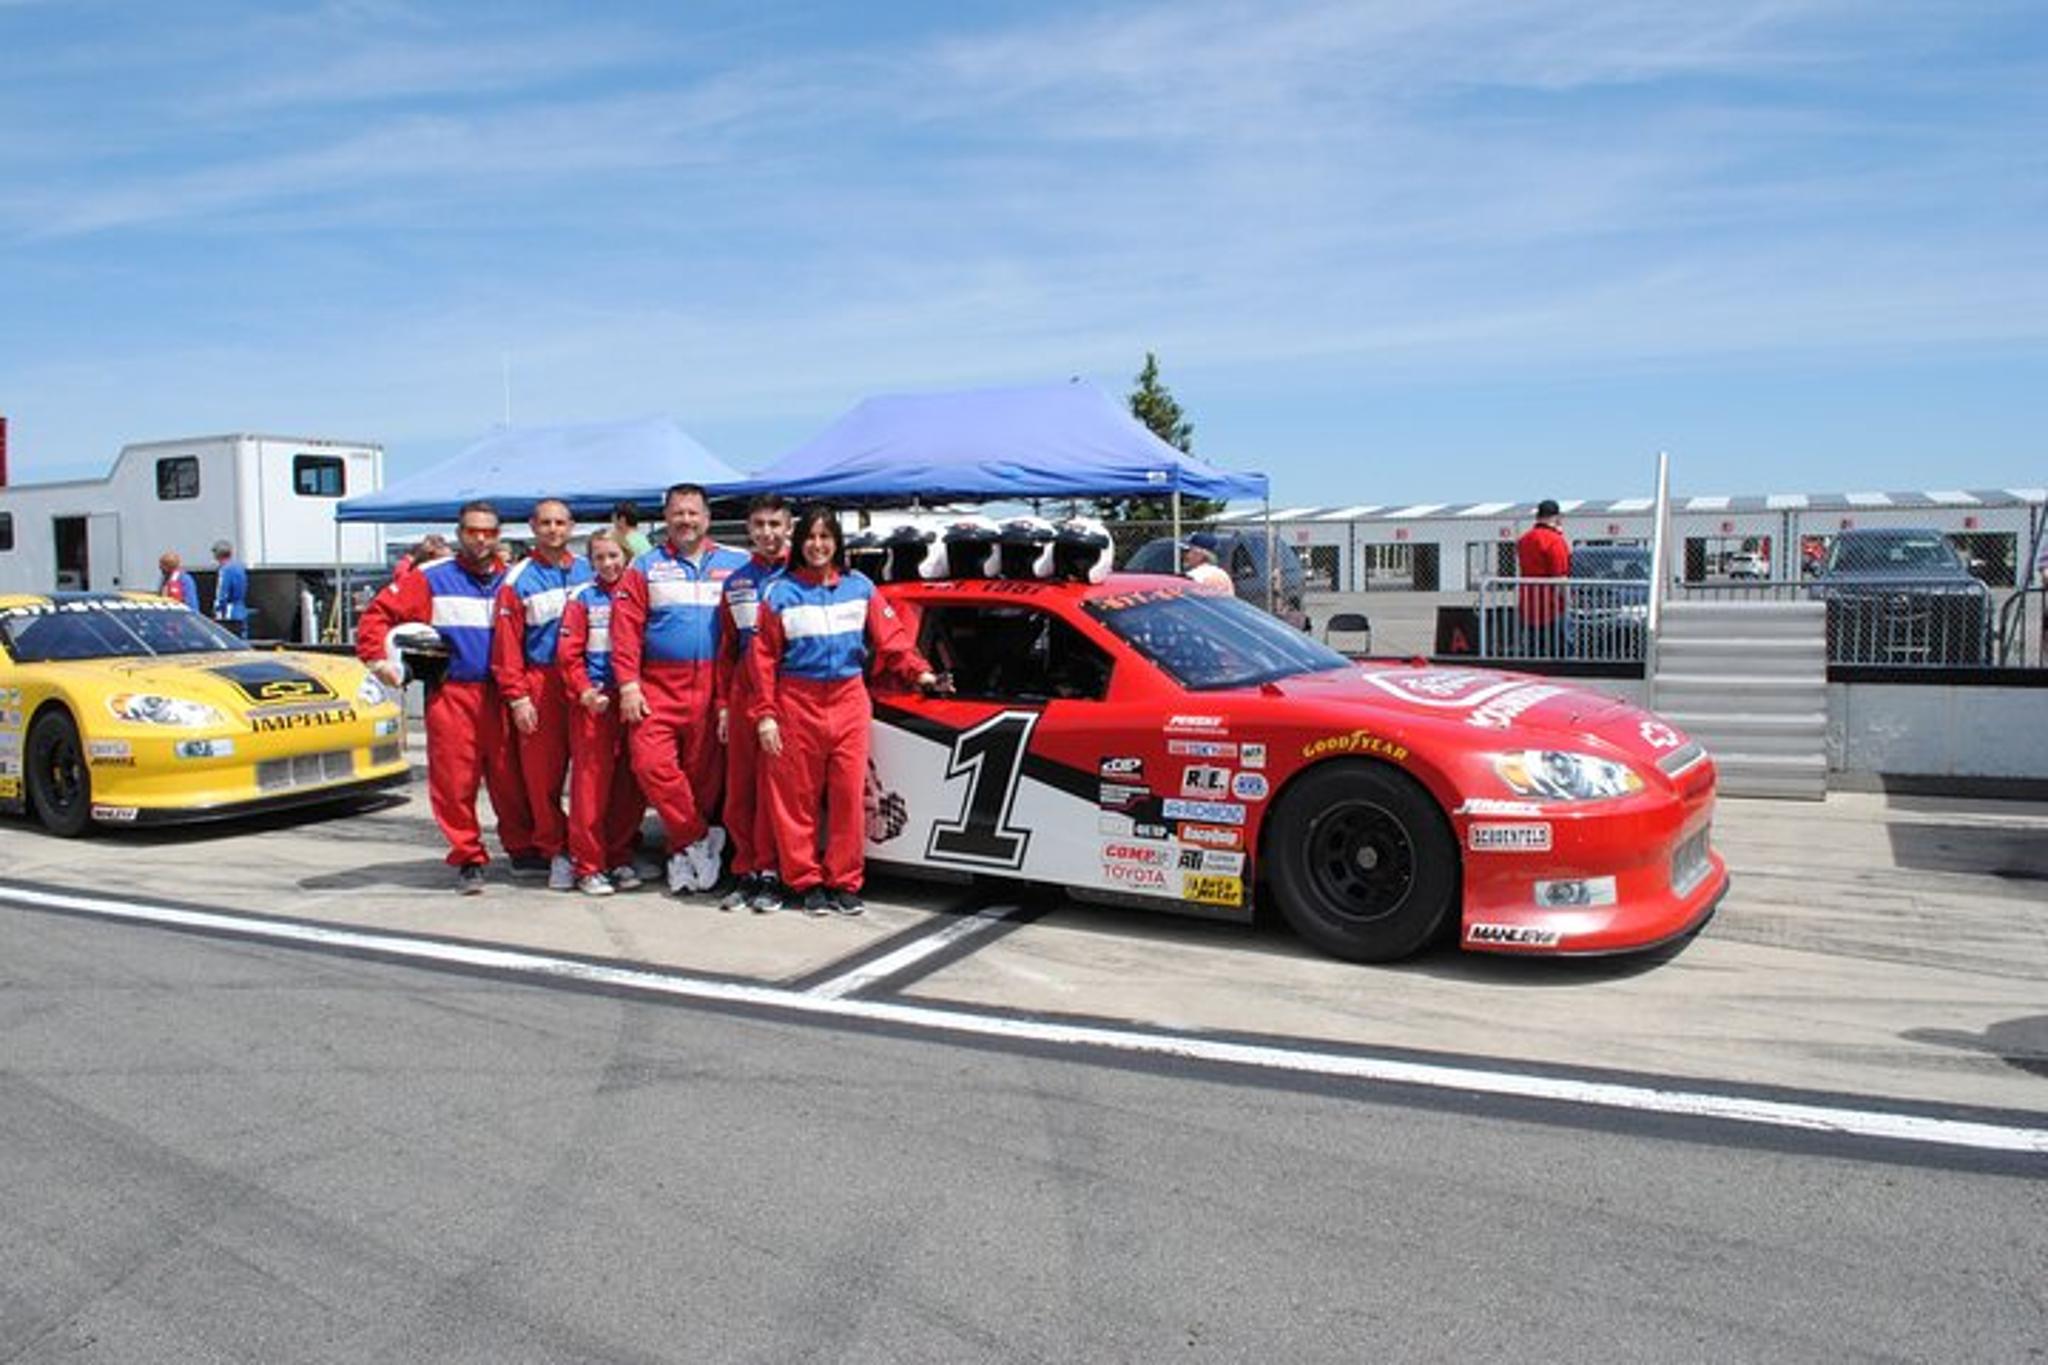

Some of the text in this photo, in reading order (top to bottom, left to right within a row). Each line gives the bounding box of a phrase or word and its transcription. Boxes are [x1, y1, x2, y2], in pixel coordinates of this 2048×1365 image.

[251, 708, 357, 732] IMPALA
[1302, 729, 1408, 760] GOODYEAR
[924, 709, 1039, 871] 1
[1104, 864, 1166, 885] TOYOTA
